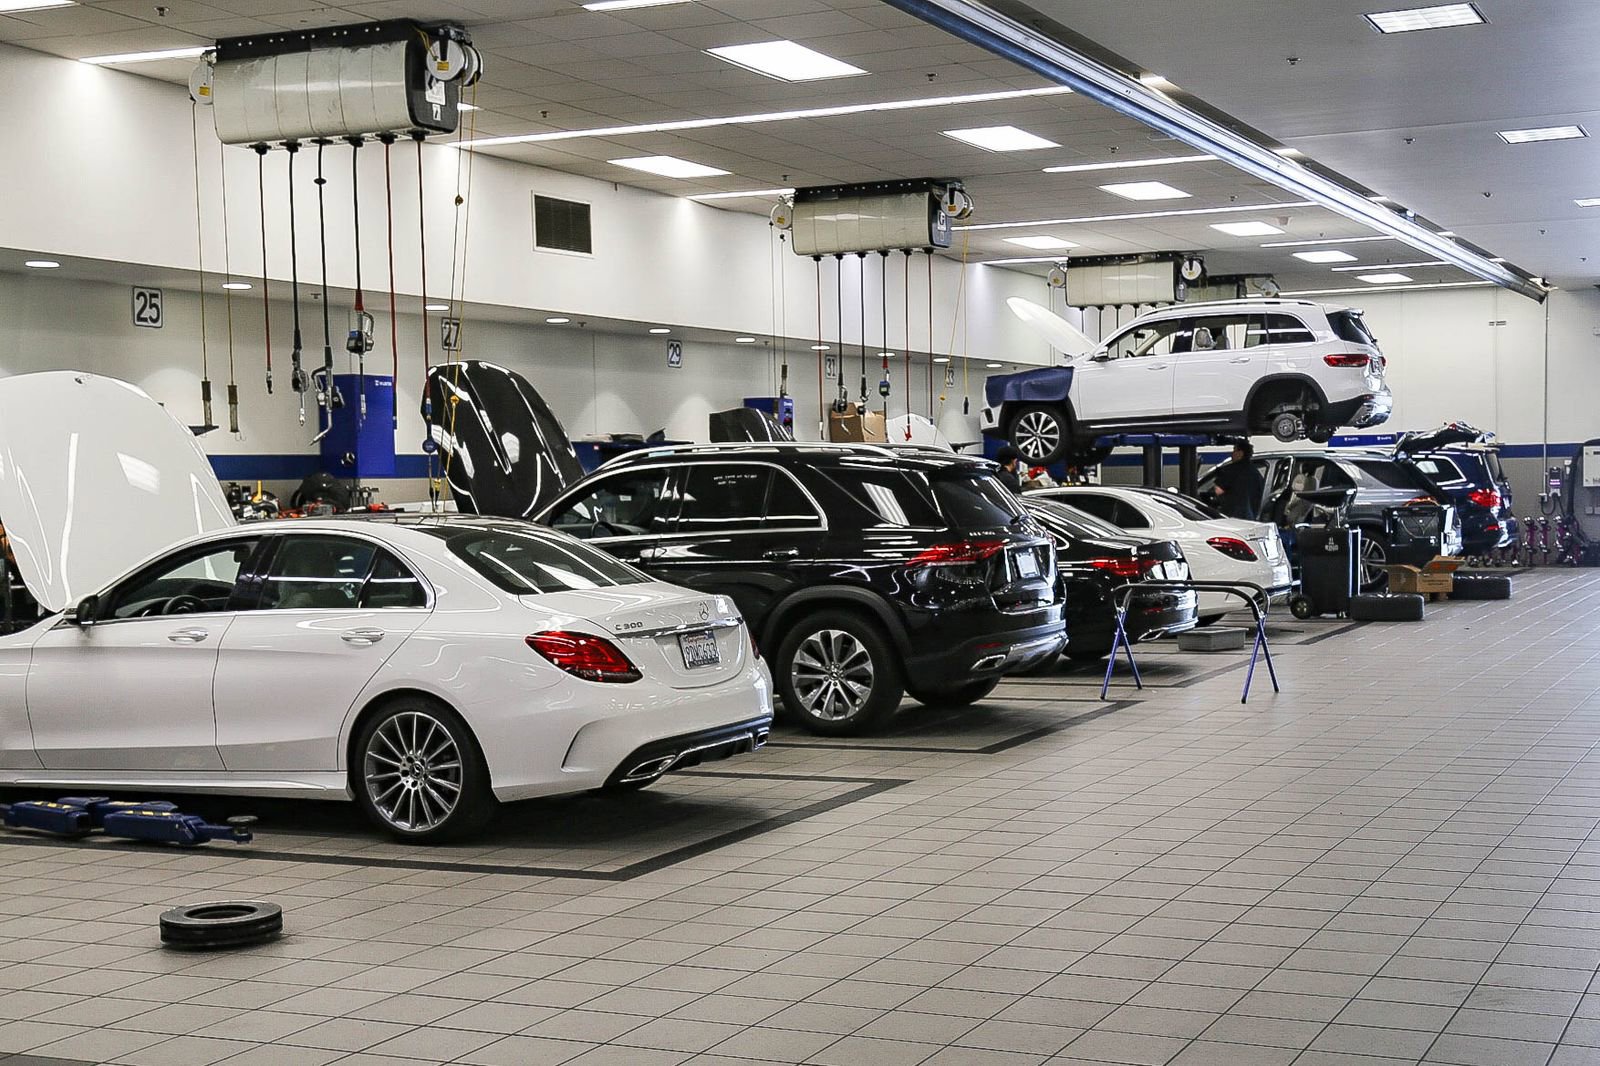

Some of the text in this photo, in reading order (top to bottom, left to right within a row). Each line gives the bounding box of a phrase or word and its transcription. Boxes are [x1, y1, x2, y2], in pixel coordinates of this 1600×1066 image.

[136, 291, 160, 323] 25
[443, 321, 460, 347] 27
[669, 342, 681, 365] 29
[624, 621, 643, 630] 300
